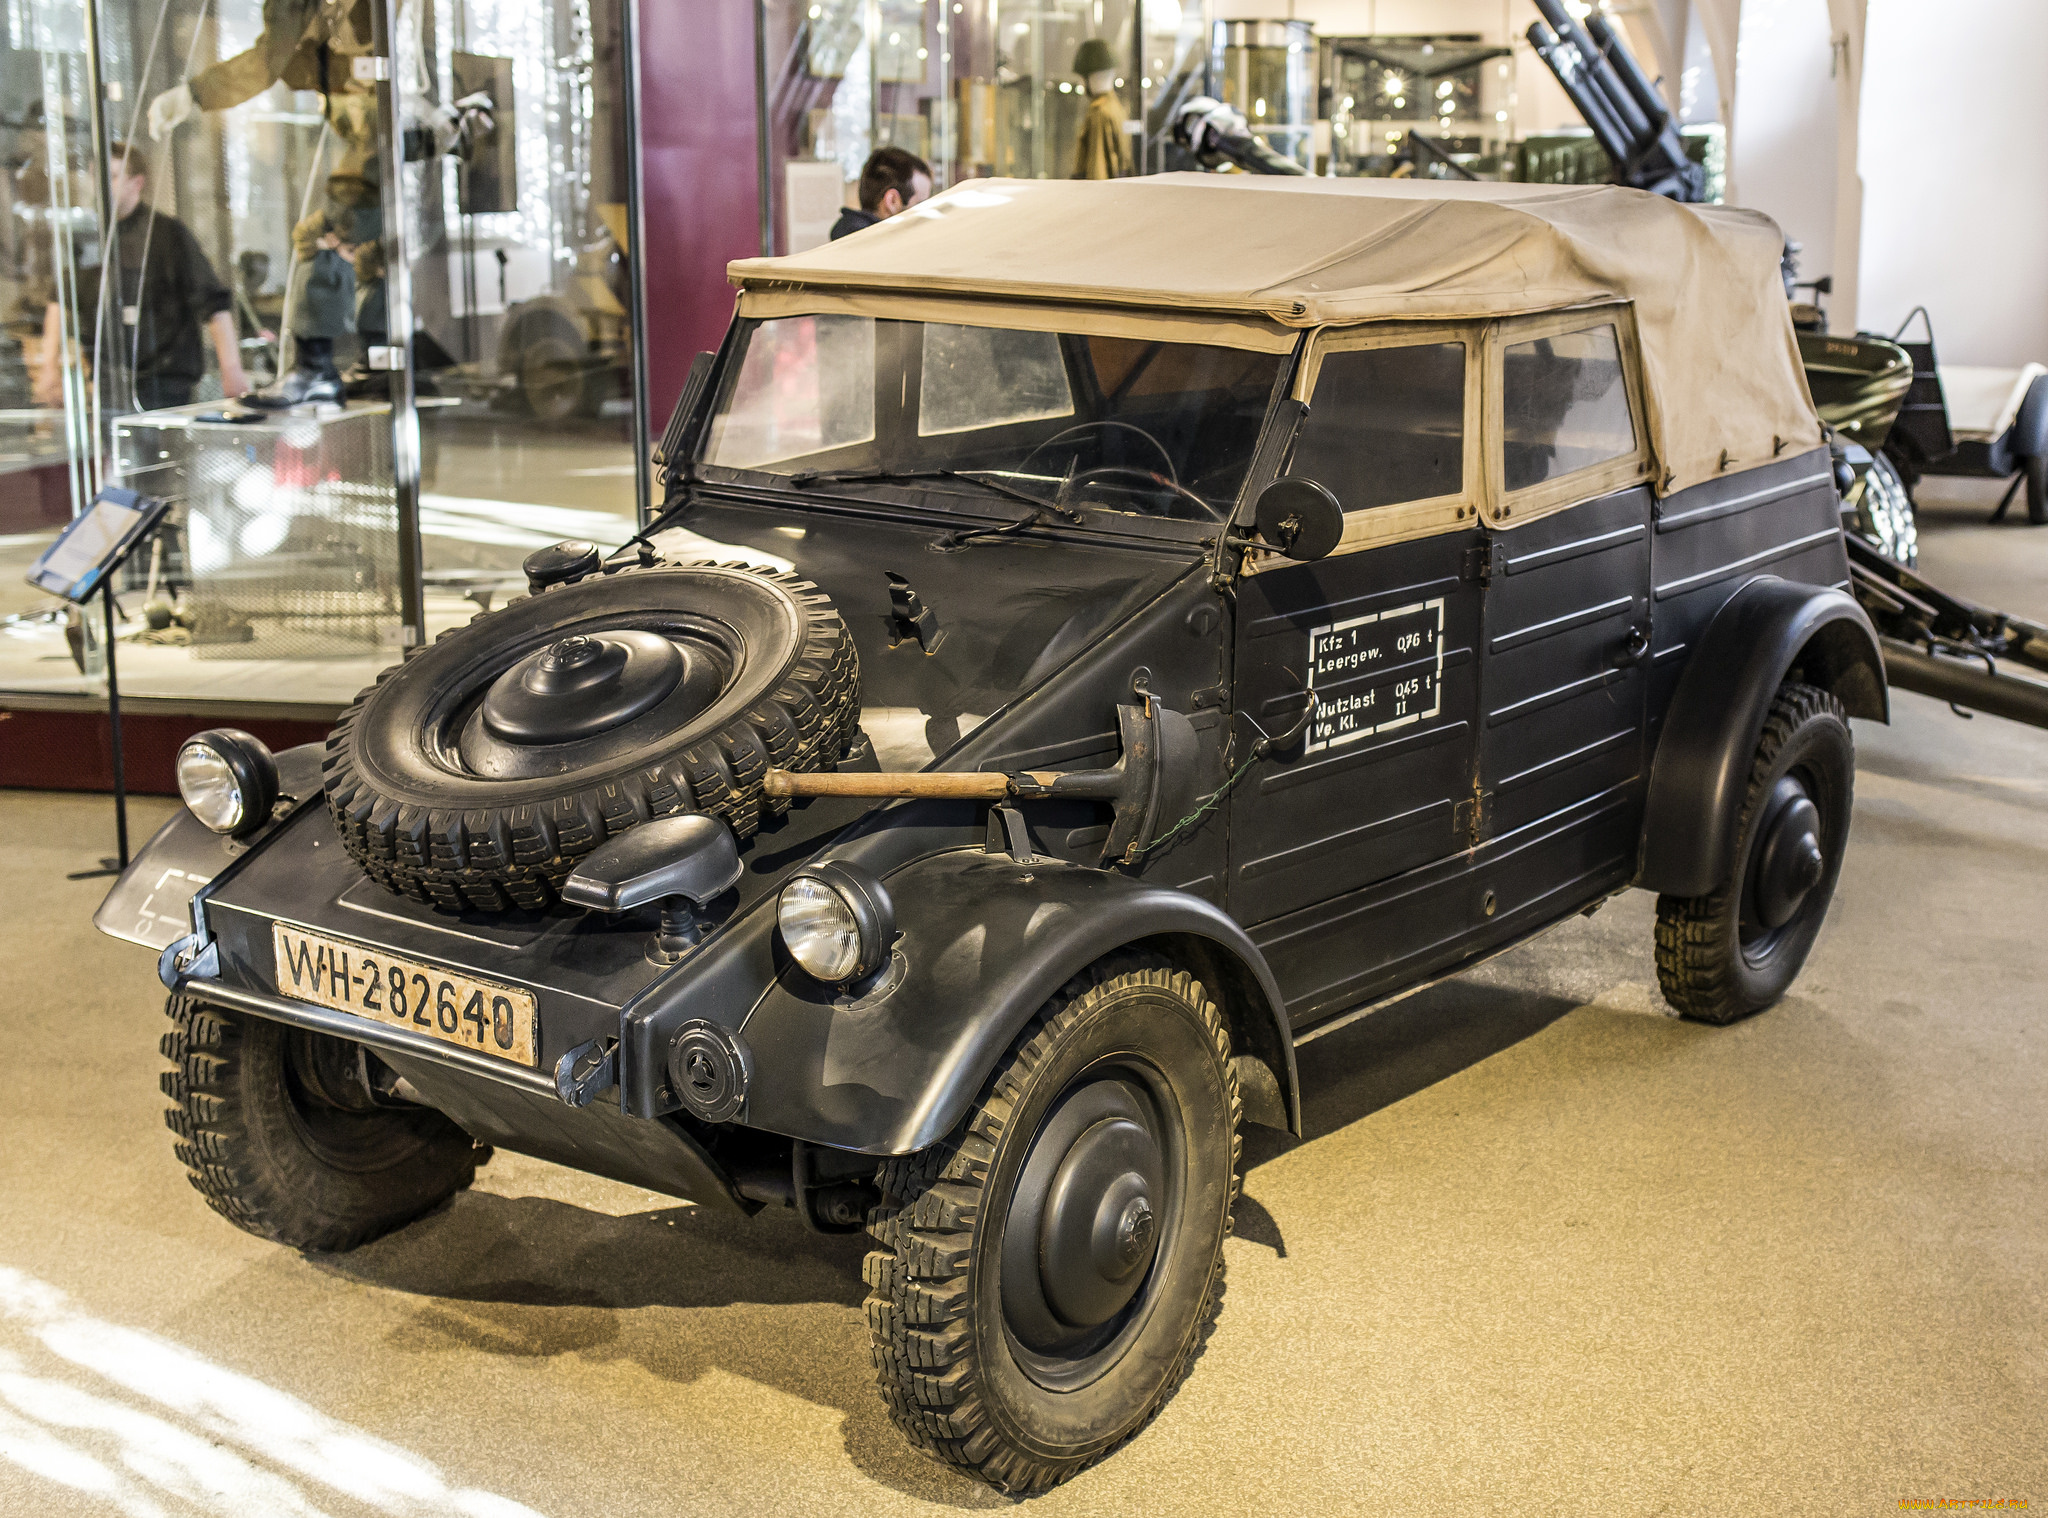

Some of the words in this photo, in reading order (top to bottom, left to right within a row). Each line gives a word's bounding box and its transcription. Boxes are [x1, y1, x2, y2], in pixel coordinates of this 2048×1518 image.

[1318, 647, 1383, 673] Leergew.
[1427, 628, 1433, 643] t
[1319, 635, 1343, 653] Kfz
[1351, 630, 1357, 645] 1
[1315, 689, 1376, 720] Nutzlast
[1425, 675, 1431, 689] t
[1315, 722, 1336, 738] Ve.
[283, 935, 514, 1050] WH-282640
